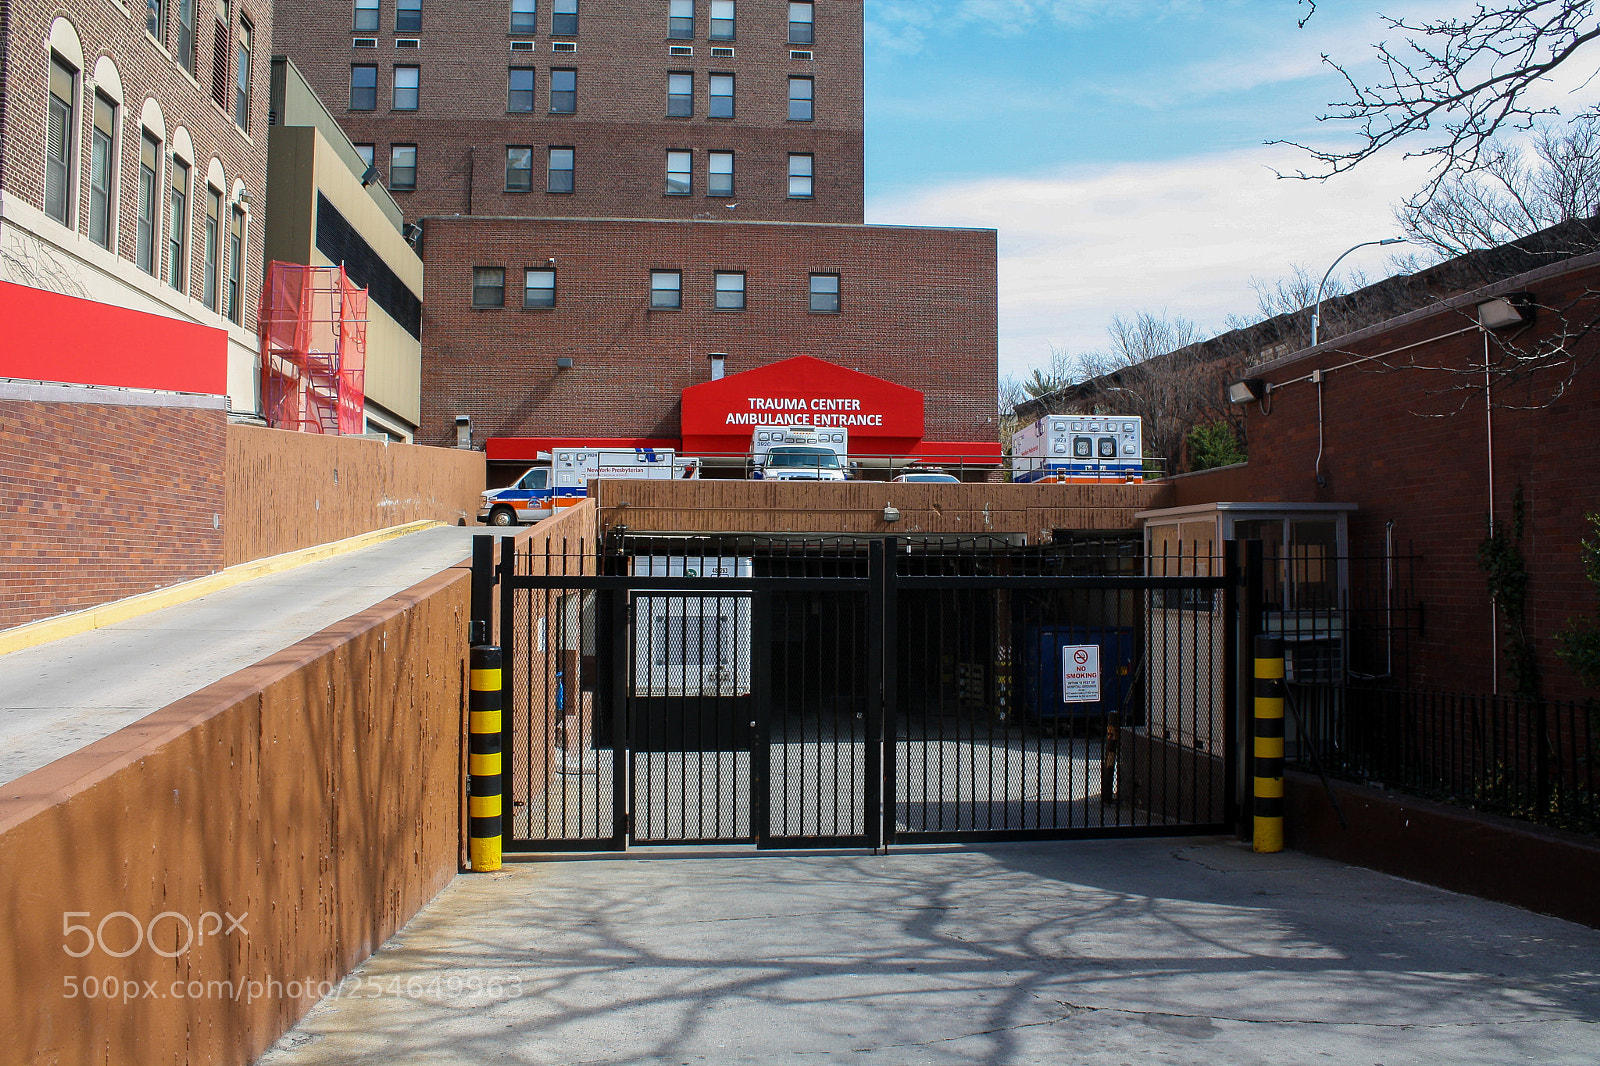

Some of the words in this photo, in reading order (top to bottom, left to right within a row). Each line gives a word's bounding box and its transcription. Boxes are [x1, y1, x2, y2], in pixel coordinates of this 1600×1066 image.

[748, 397, 807, 410] TRAUMA
[811, 398, 861, 410] CENTER
[725, 413, 810, 425] AMBULANCE
[813, 414, 883, 426] ENTRANCE
